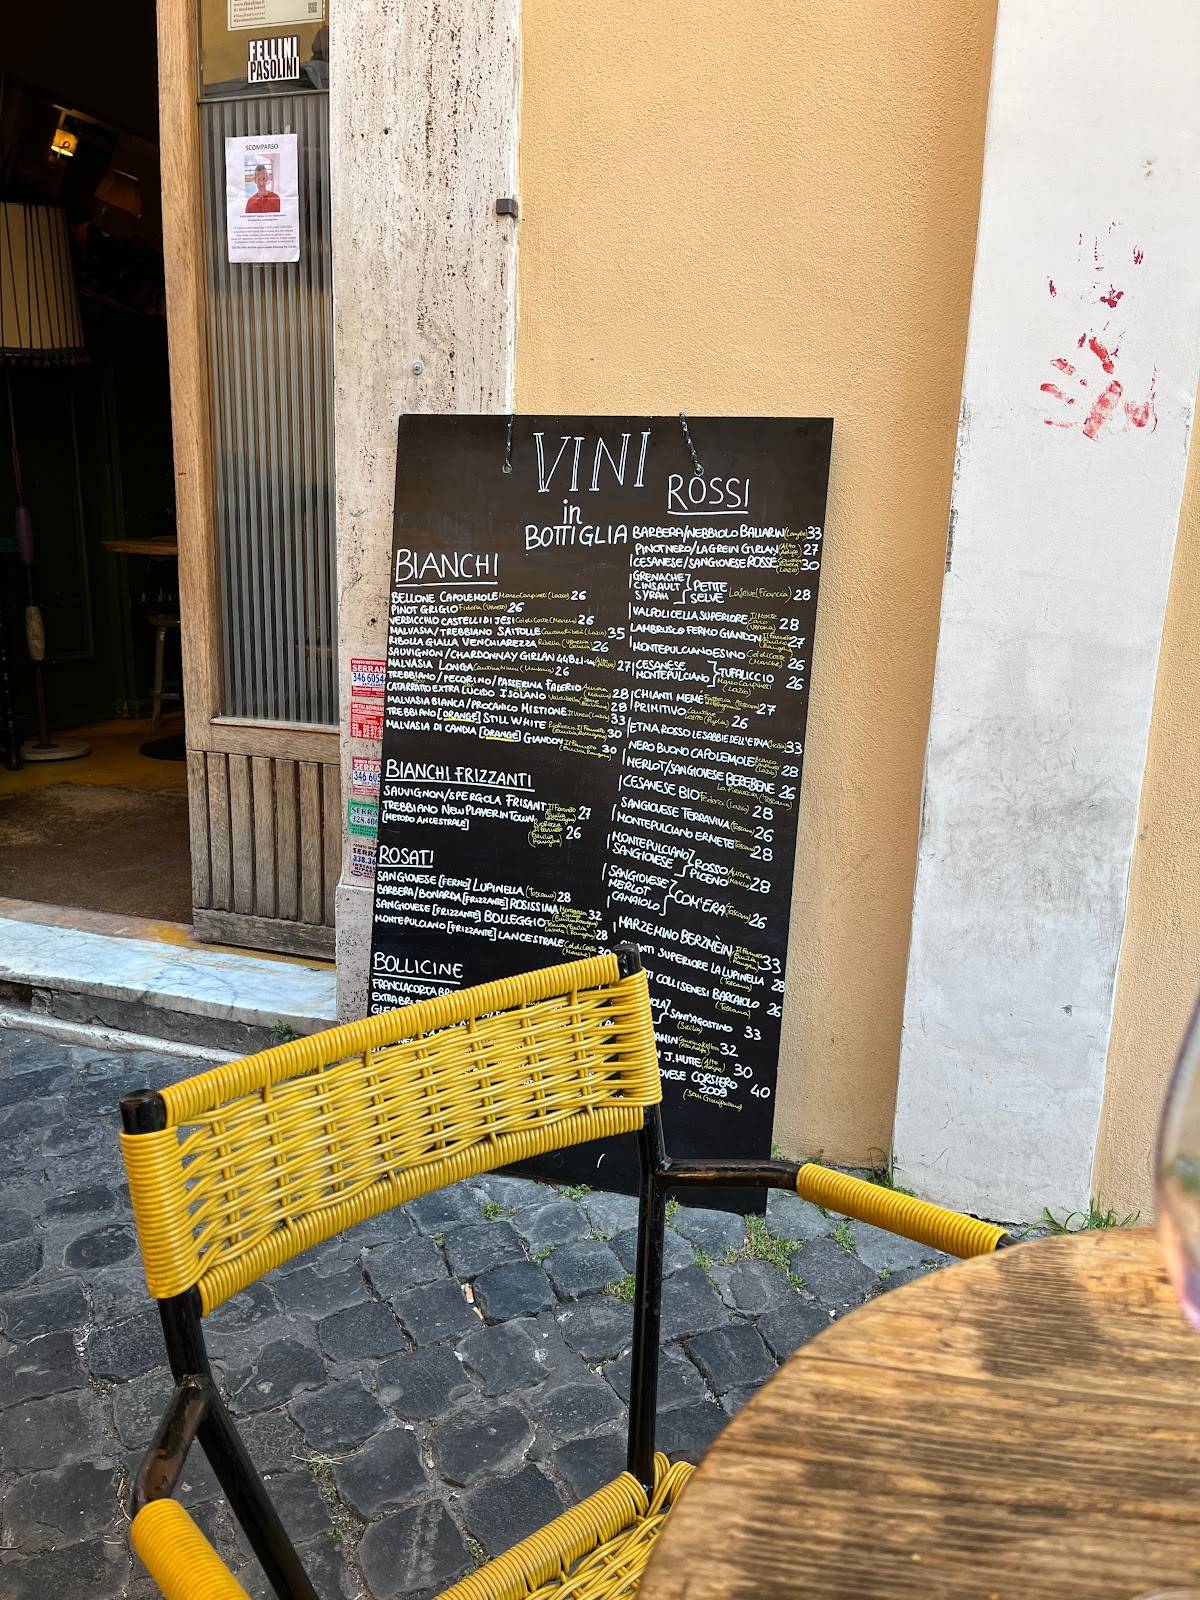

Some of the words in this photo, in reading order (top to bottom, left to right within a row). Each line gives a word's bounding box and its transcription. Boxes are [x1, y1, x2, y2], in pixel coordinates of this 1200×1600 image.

[250, 36, 298, 61] FELLINI
[250, 57, 297, 80] PASOLINI
[533, 432, 652, 492] VINI
[668, 474, 750, 510] ROSSI
[524, 524, 628, 550] BOTTIGLIA
[806, 526, 822, 540] 33
[803, 544, 819, 556] 27
[395, 549, 498, 582] BIANCHI
[800, 559, 820, 570] 30
[633, 570, 684, 582] GRENACHE
[634, 582, 680, 592] CINSAULT
[391, 592, 436, 604] BELLONE
[570, 590, 587, 600] 26
[635, 590, 669, 601] SYRAH
[690, 592, 724, 604] SELVE
[793, 589, 811, 600] 28
[391, 604, 418, 615] PINOT
[420, 605, 458, 614] GRIGIO
[507, 602, 524, 613] 26
[578, 614, 594, 625] 26
[779, 618, 800, 631] 28
[608, 627, 626, 640] 35
[592, 640, 609, 652] 26
[788, 636, 806, 648] 27
[555, 666, 570, 676] 26
[617, 660, 631, 672] 27
[636, 660, 686, 671] CESANESE
[788, 658, 805, 670] 26
[786, 676, 804, 690] 26
[612, 688, 629, 700] 28
[610, 702, 627, 712] 28
[756, 703, 776, 716] 27
[610, 714, 626, 726] 33
[731, 715, 749, 729] 26
[607, 729, 622, 738] 30
[602, 744, 617, 754] 30
[785, 741, 802, 754] 33
[628, 740, 654, 752] NERO
[781, 765, 798, 778] 28
[386, 758, 450, 781] BIANCHI
[455, 767, 531, 788] FRIZZANTI
[623, 774, 676, 796] CESANESE
[752, 806, 774, 820] 28
[778, 785, 796, 800] 26
[578, 806, 592, 820] 27
[566, 826, 582, 840] 26
[754, 826, 774, 842] 26
[380, 845, 434, 866] ROSATI
[750, 846, 773, 862] 28
[695, 859, 728, 875] ROSSO
[750, 877, 771, 894] 28
[377, 871, 436, 884] SANGIOVESE
[557, 892, 572, 902] 28
[608, 879, 652, 896] MERLOT
[588, 910, 602, 920] 32
[749, 913, 768, 929] 26
[596, 930, 608, 940] 28
[373, 952, 464, 978] BOLLICINE
[758, 955, 781, 974] 33
[771, 979, 785, 992] 28
[766, 1003, 782, 1018] 26
[744, 1026, 762, 1040] 33
[720, 1042, 738, 1058] 32
[733, 1063, 753, 1078] 30
[698, 1084, 728, 1098] 2009
[750, 1084, 770, 1098] 40
